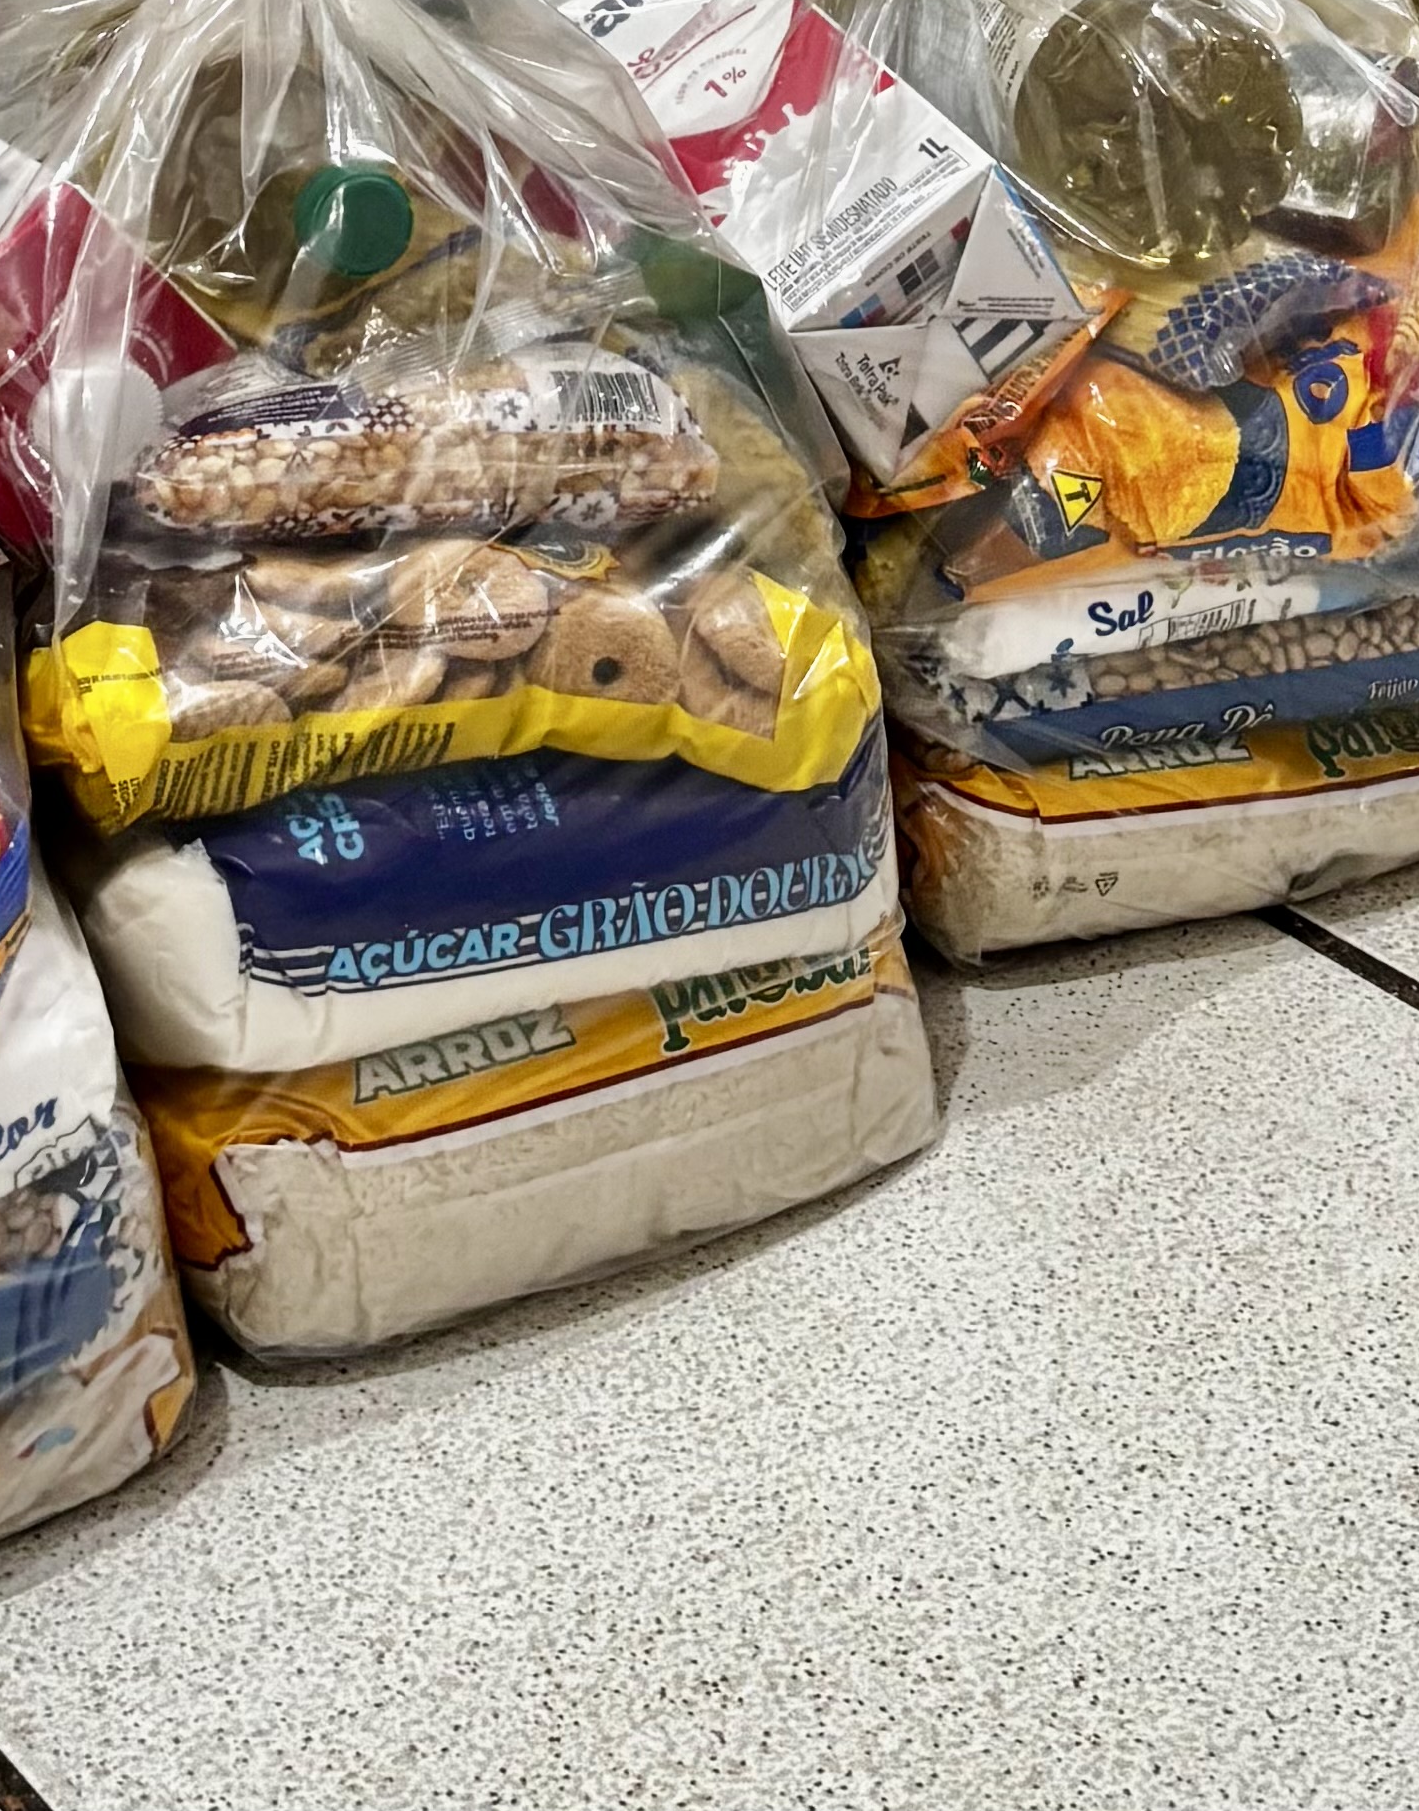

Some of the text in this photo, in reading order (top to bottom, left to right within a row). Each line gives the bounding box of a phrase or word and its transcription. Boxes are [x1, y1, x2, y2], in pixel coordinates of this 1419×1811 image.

[703, 67, 747, 98] 1%
[918, 137, 950, 159] 1L
[763, 259, 798, 292] LEITE
[810, 176, 898, 254] SEMIDESNATADO
[1088, 591, 1155, 637] Sal
[325, 920, 522, 988] AÇÚCAR
[538, 879, 696, 960] GRÃO
[353, 1004, 577, 1106] ARROZ
